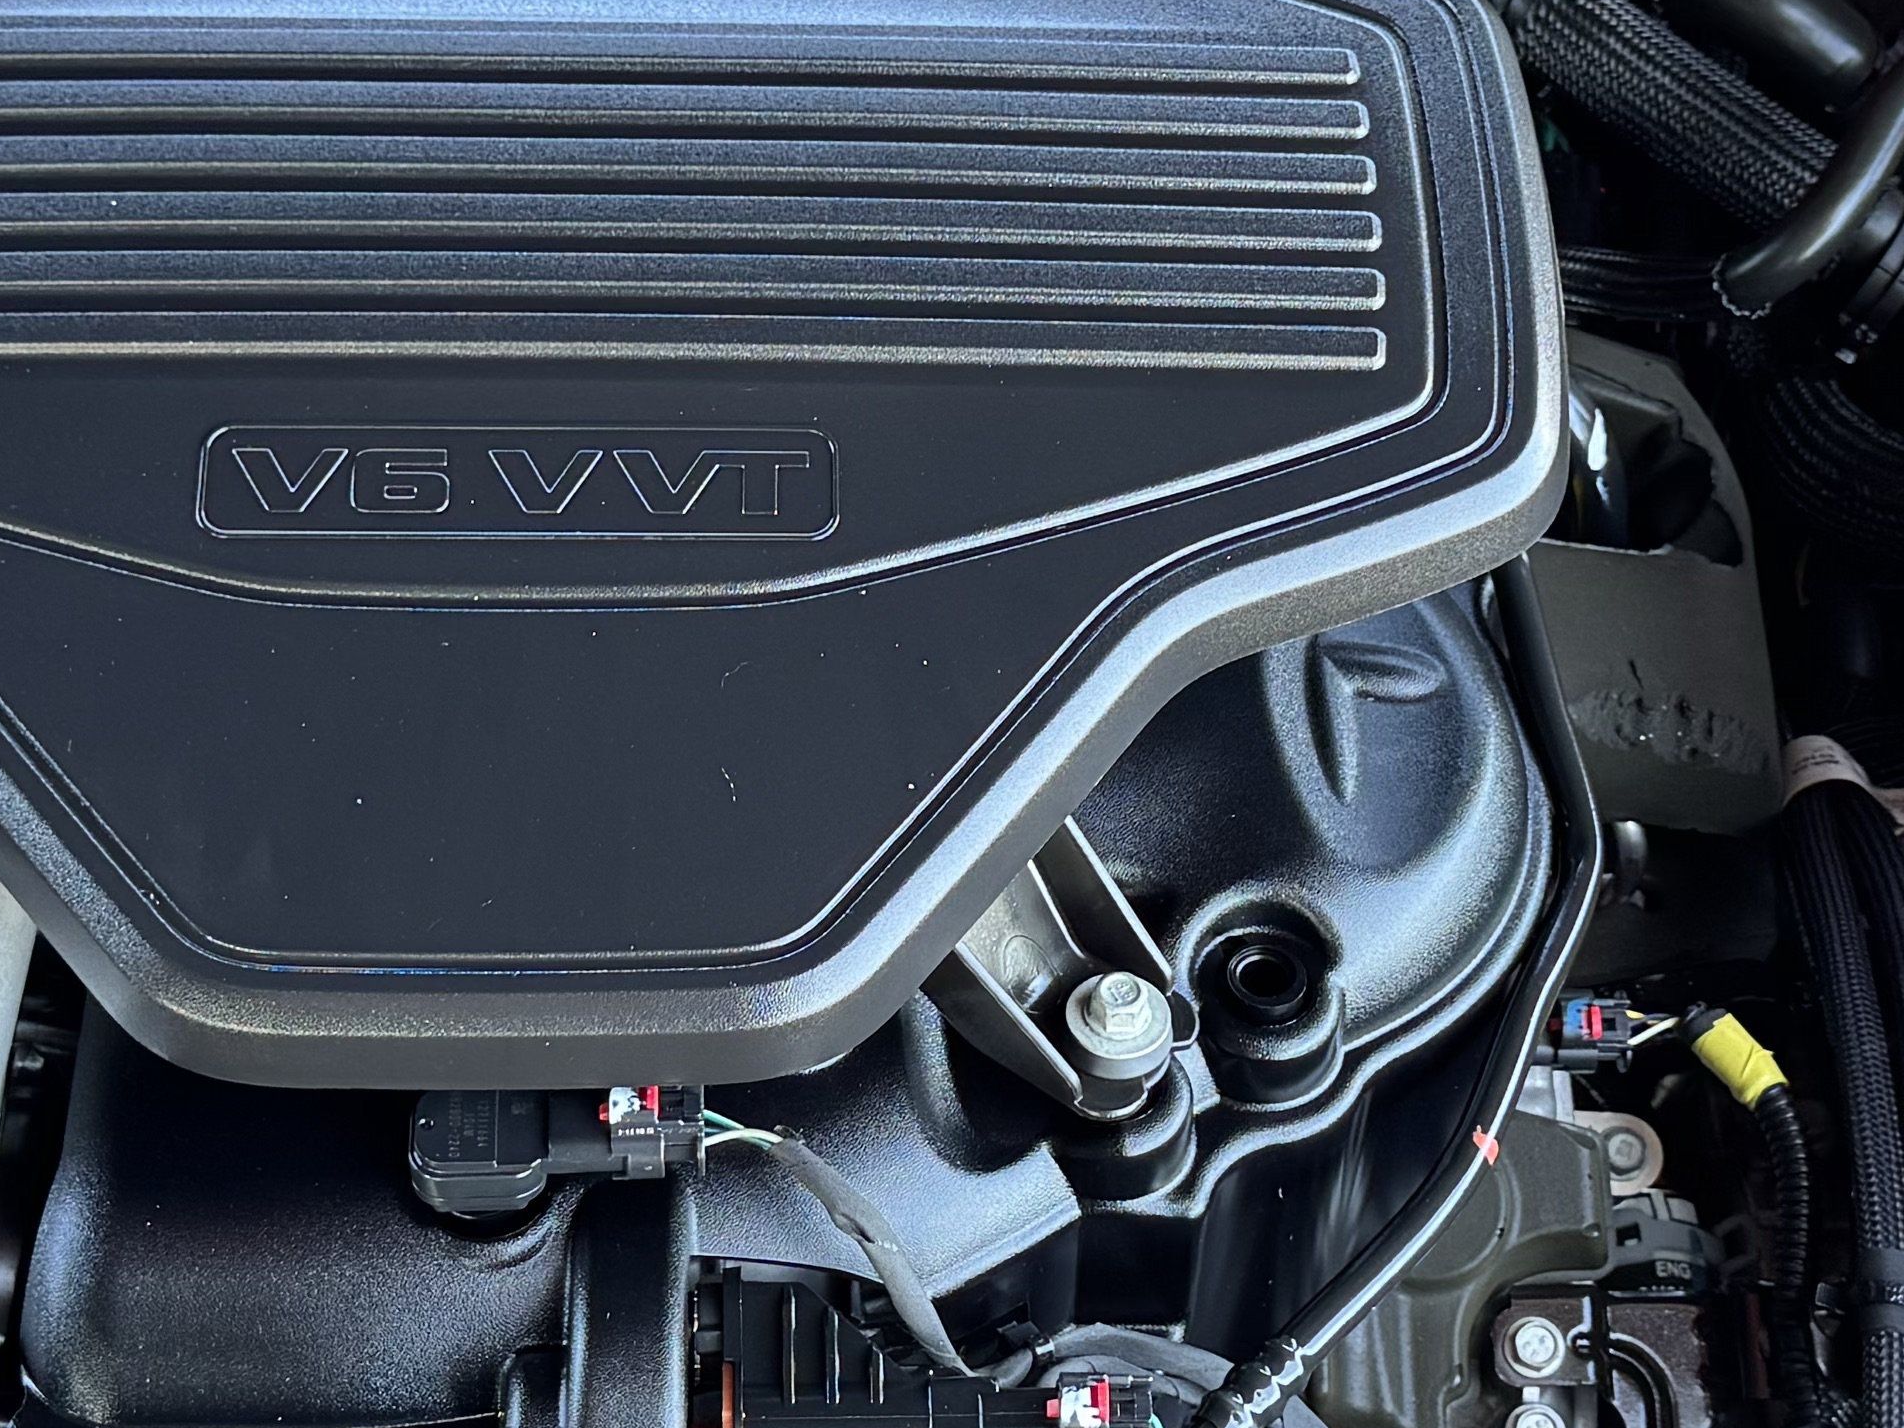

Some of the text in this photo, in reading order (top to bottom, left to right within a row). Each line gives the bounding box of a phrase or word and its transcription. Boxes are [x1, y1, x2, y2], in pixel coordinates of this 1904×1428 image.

[233, 448, 810, 515] V6 VVT
[1654, 1260, 1693, 1281] ENG
